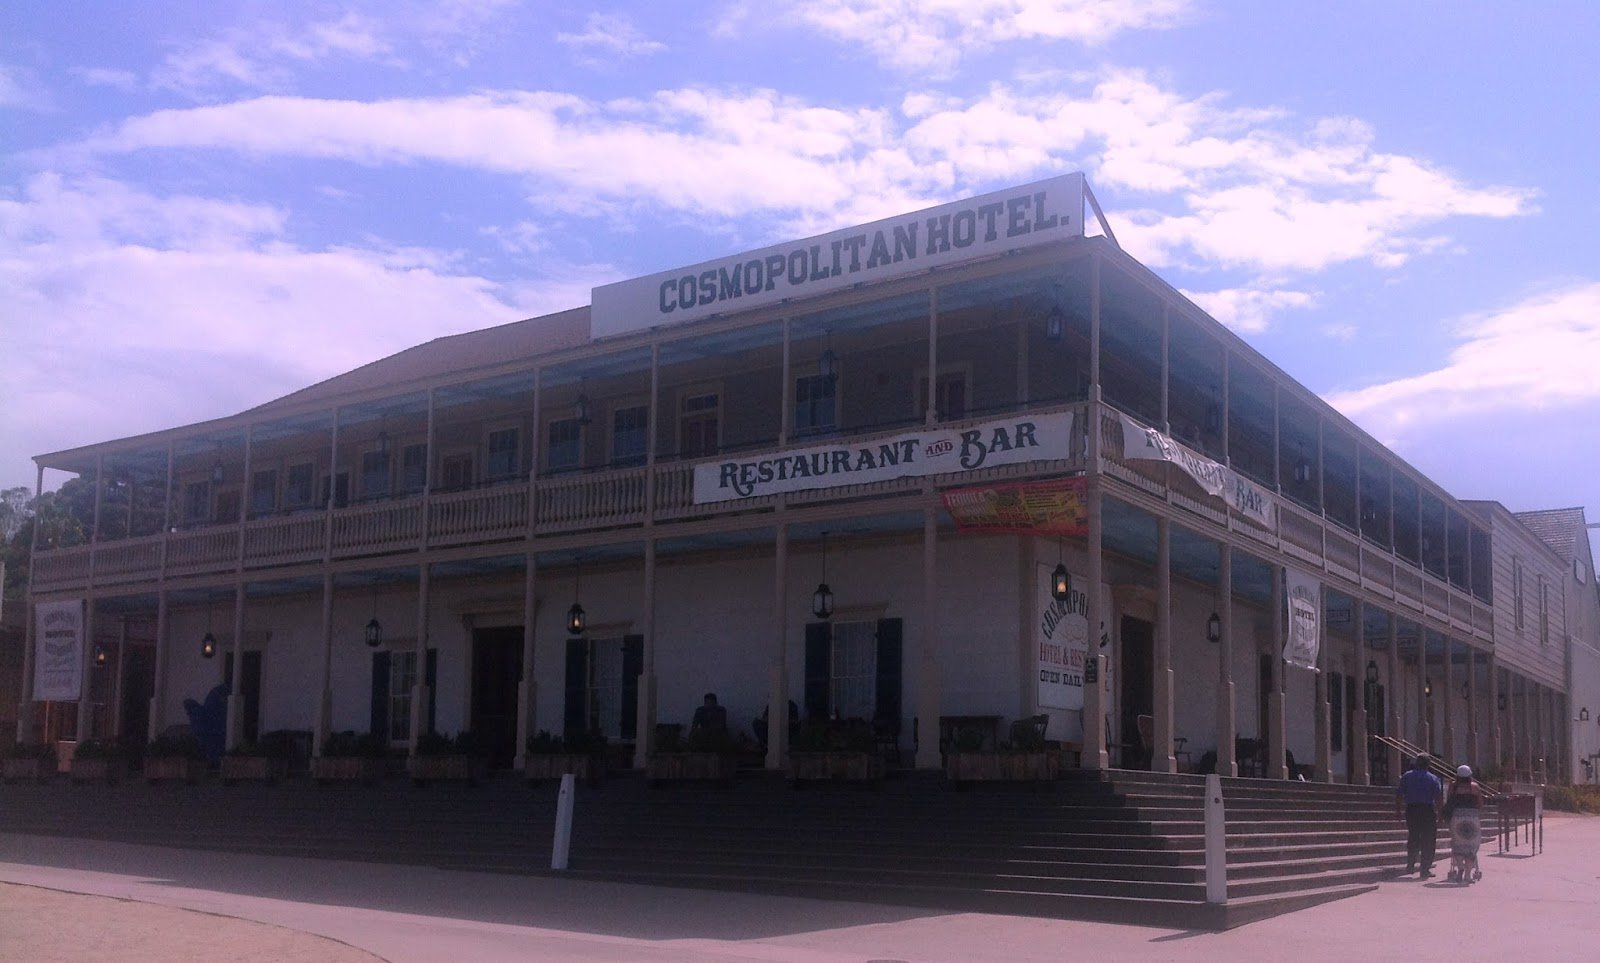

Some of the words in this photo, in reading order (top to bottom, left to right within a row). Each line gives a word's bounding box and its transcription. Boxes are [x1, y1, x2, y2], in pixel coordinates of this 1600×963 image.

[658, 221, 919, 313] COSMOPOLITAN
[926, 191, 1070, 255] HOTEL.
[718, 438, 920, 497] RESTAURANT
[925, 440, 954, 457] AND
[960, 422, 1041, 470] BAR
[1039, 641, 1062, 665] HOTEL
[1062, 647, 1069, 666] &
[1039, 669, 1061, 684] OPEN
[1062, 673, 1084, 687] DAIL
